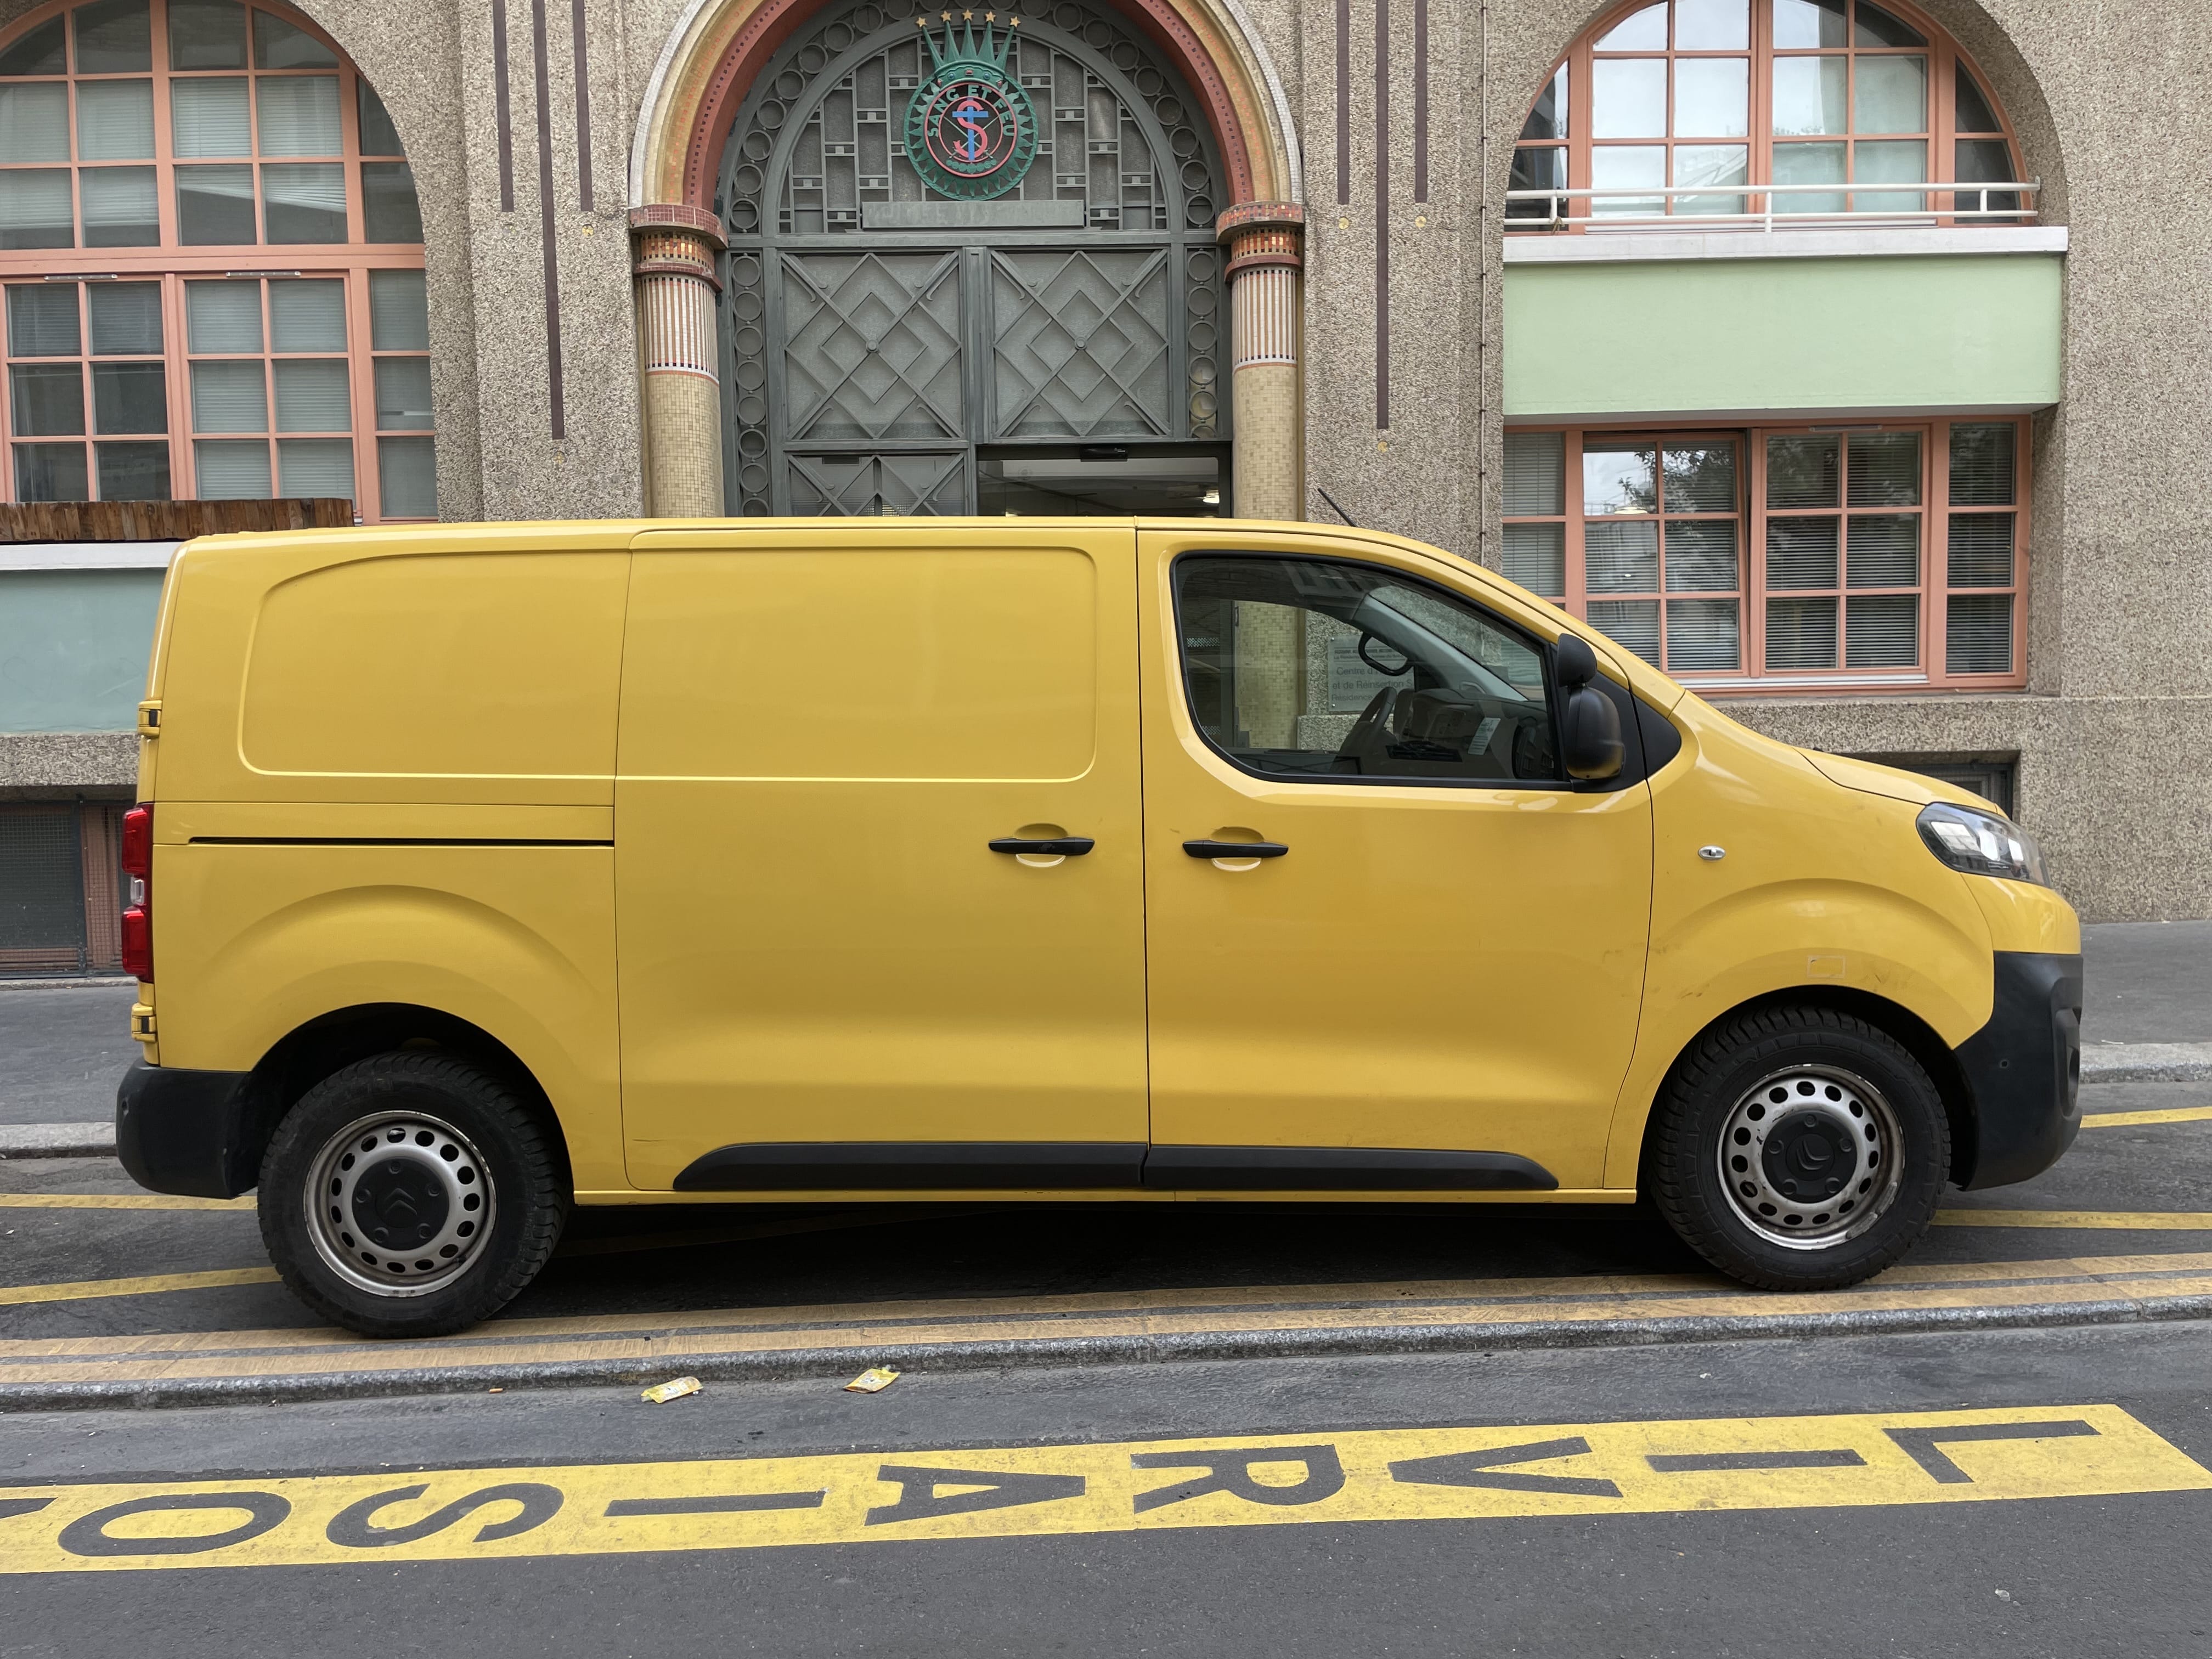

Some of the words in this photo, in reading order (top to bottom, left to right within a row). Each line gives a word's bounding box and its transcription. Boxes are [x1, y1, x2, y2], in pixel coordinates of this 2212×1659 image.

[928, 88, 960, 137] SANG
[968, 84, 991, 99] ET
[993, 98, 1014, 137] FEU
[1336, 667, 1365, 675] Centre
[1343, 681, 1354, 689] de
[0, 1420, 2103, 1557] LIVRAISO
